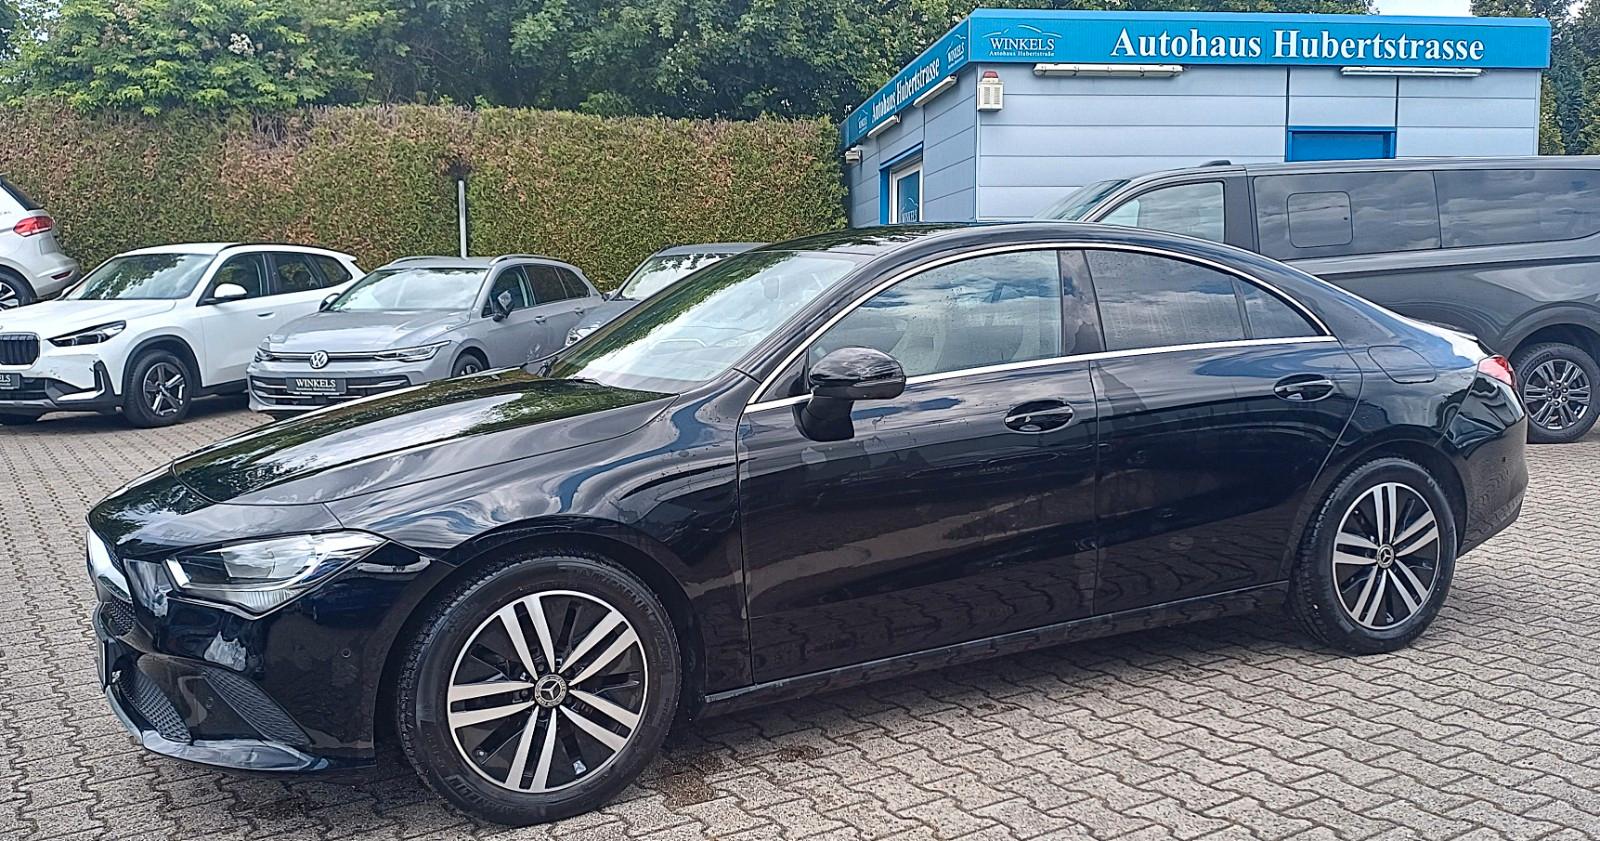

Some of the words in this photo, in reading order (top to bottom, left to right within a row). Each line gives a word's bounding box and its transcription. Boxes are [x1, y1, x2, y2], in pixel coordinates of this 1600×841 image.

[989, 37, 1055, 51] WINKELS
[1110, 28, 1262, 58] Autohaus
[1272, 29, 1485, 61] Hubertstrasse
[871, 91, 896, 123] Autohaus
[896, 57, 940, 105] Hubertstrasse
[295, 378, 336, 388] WINKELS
